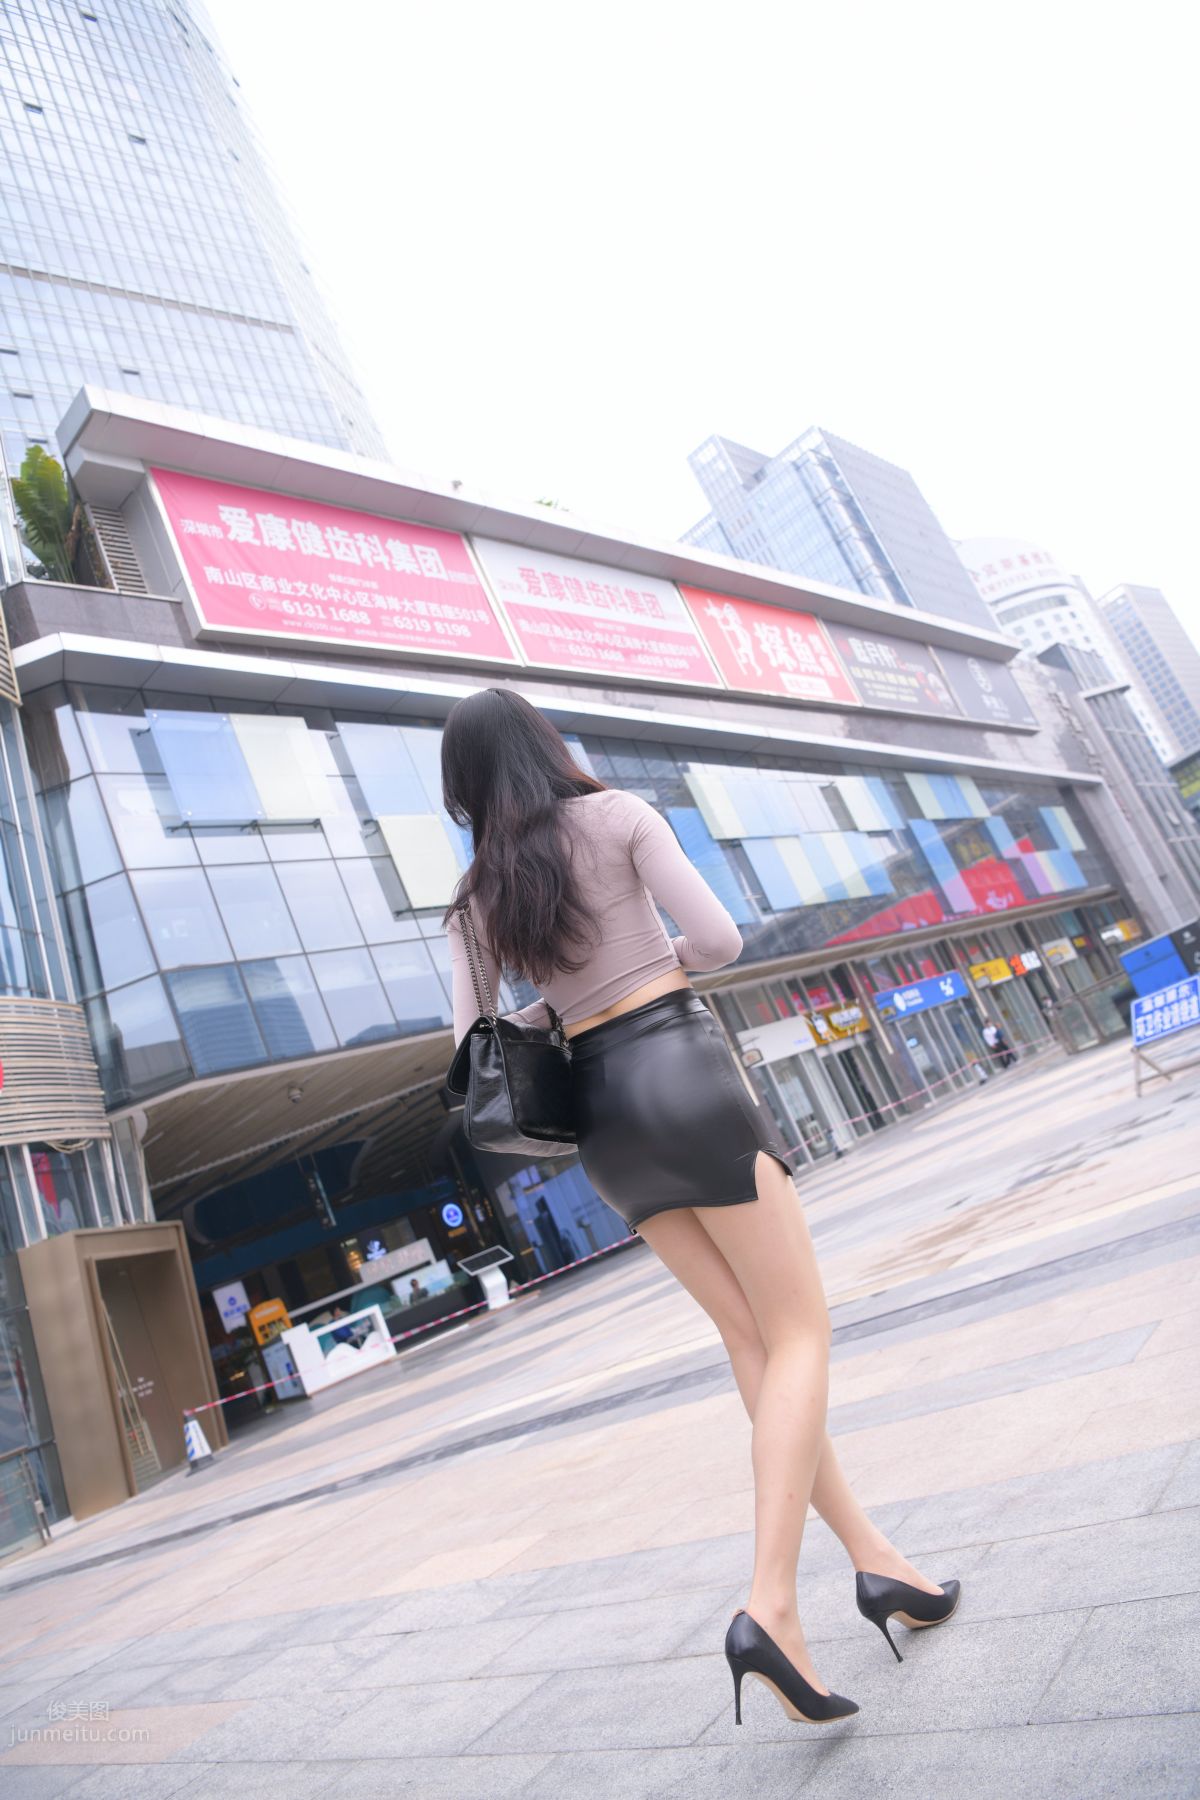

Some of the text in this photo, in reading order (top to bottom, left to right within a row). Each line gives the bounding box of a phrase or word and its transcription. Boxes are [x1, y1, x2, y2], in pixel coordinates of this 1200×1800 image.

[217, 504, 451, 582] 爱康健齿科集团
